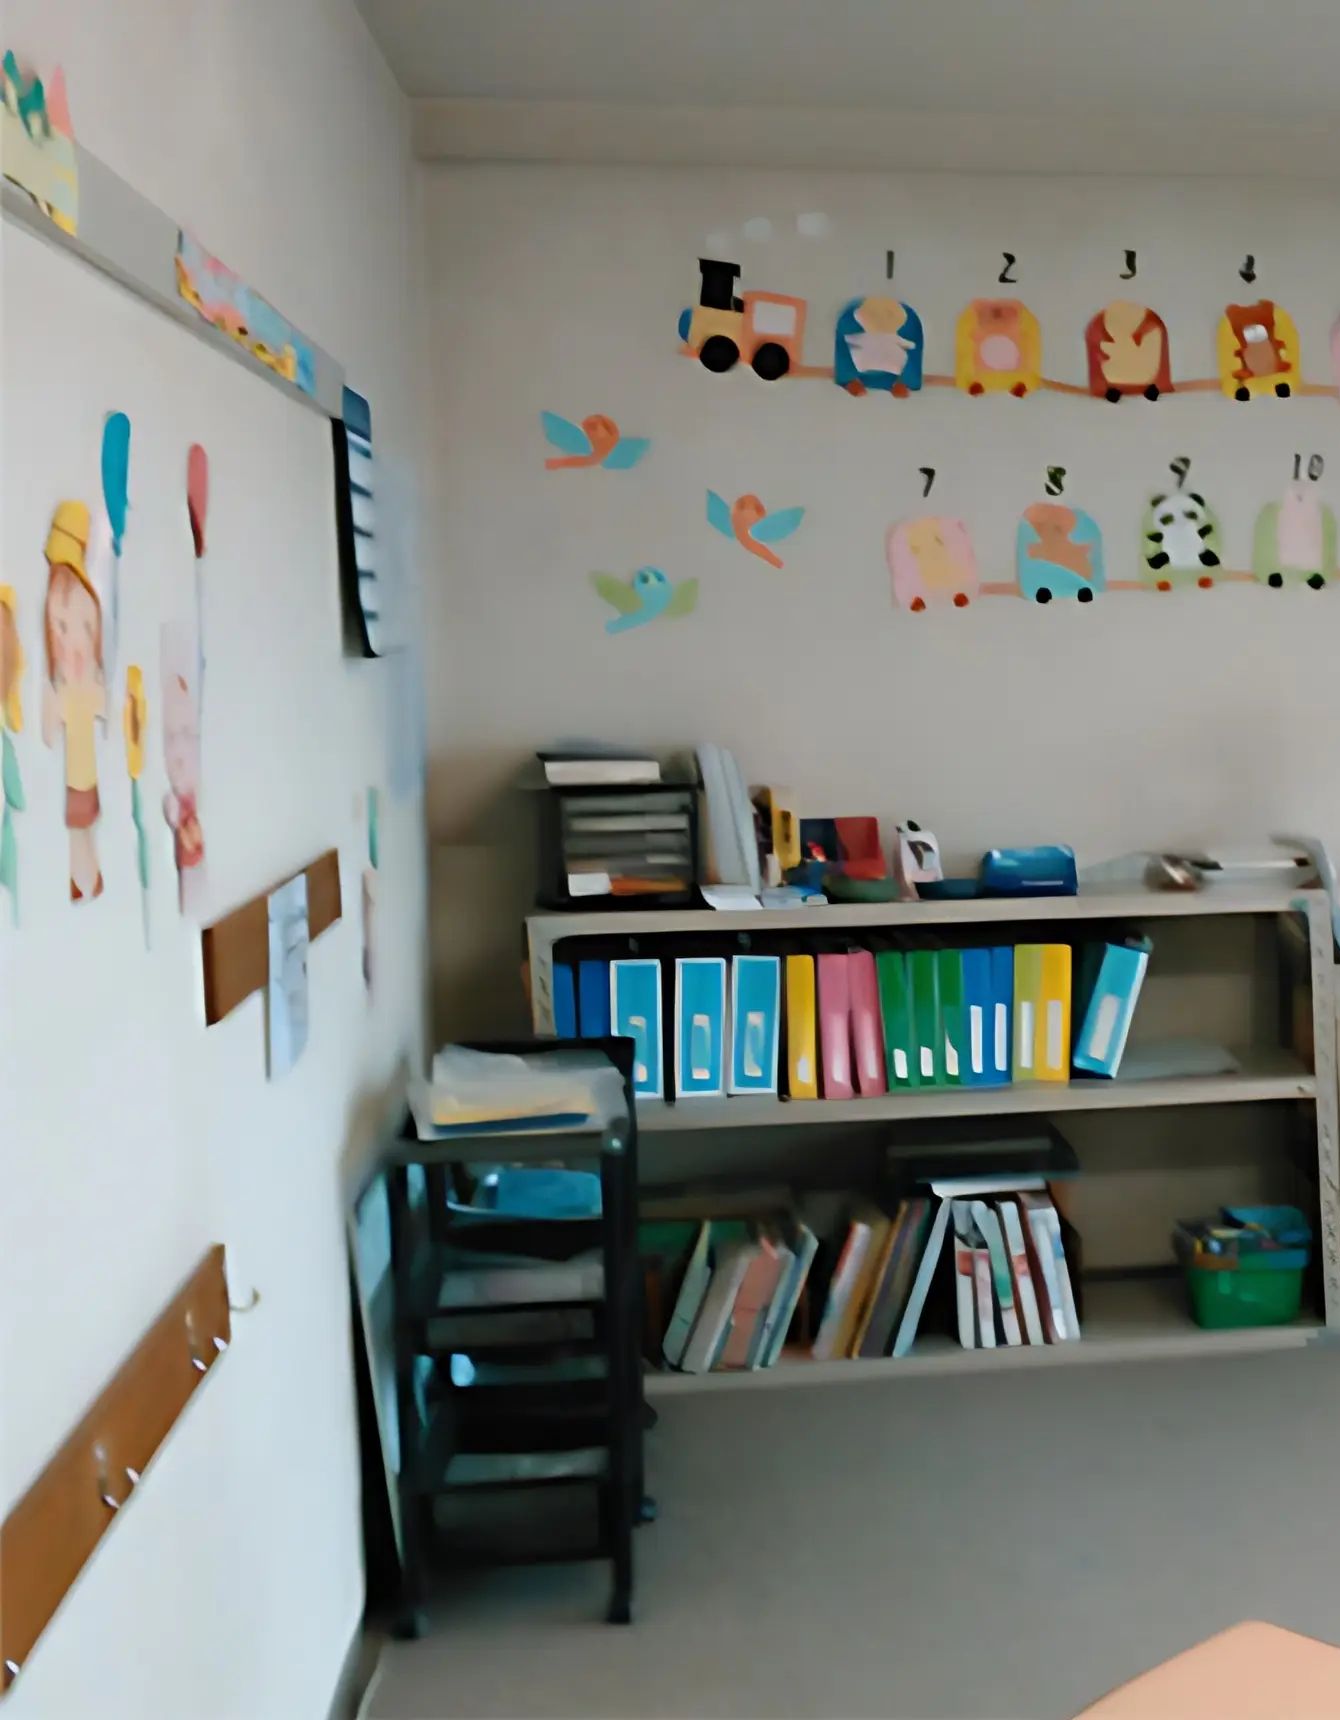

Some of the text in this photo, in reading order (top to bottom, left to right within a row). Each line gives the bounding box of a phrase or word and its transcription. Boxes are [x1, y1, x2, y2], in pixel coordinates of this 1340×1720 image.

[885, 249, 895, 280] 1
[997, 252, 1018, 284] 2
[1119, 250, 1137, 281] 3
[917, 466, 937, 499] 7
[1168, 455, 1191, 490] 9
[1292, 452, 1325, 482] 10
